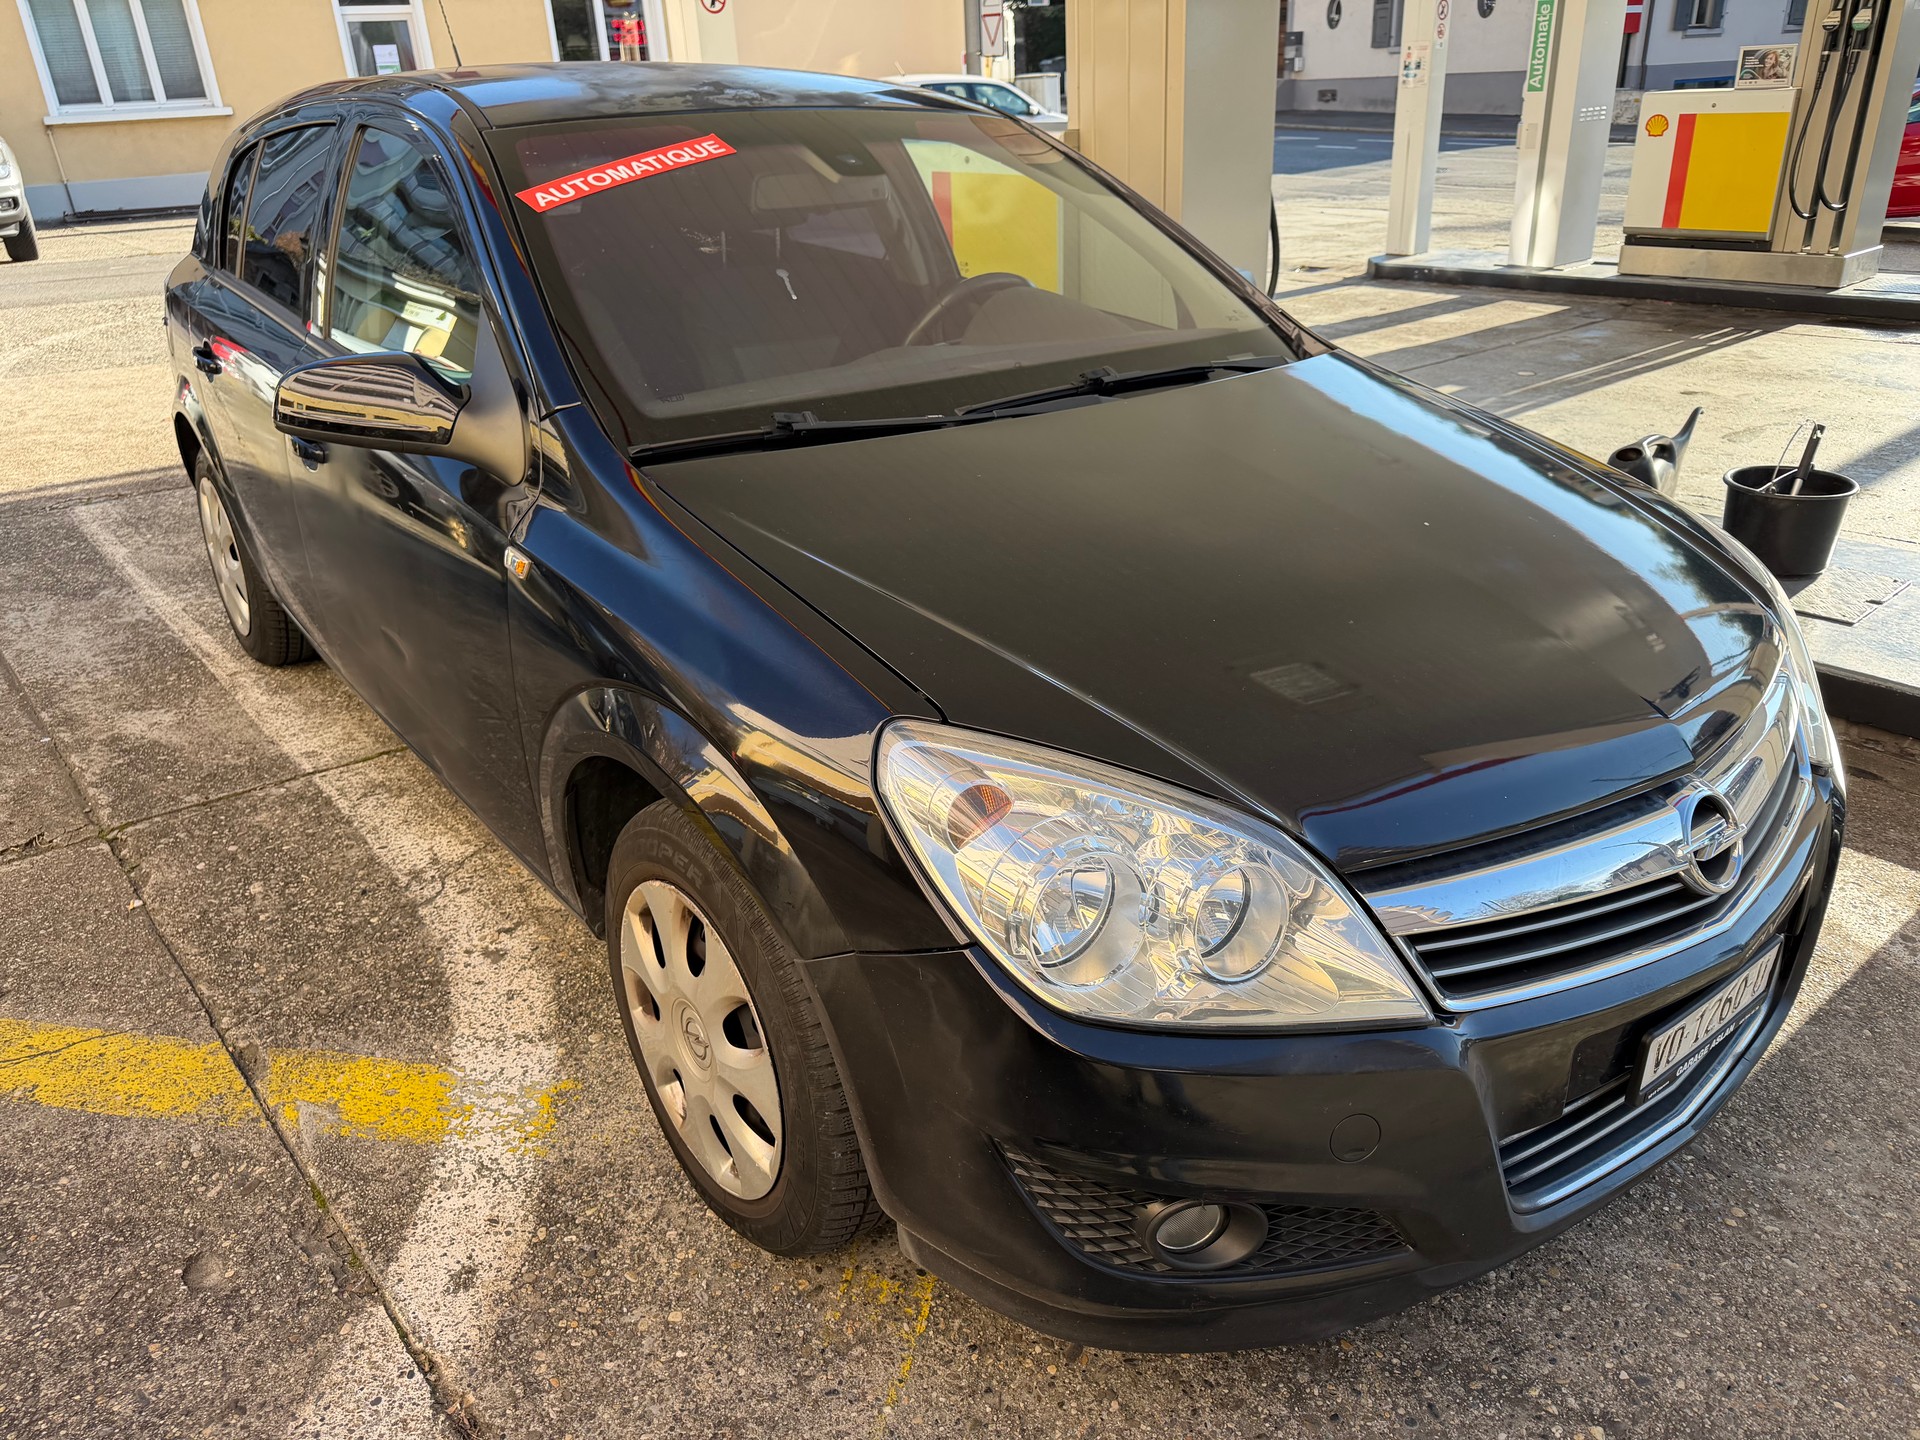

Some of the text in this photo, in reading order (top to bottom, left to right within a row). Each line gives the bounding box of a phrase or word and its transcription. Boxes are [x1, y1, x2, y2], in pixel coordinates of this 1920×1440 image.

[1529, 4, 1551, 88] Automate
[534, 140, 727, 207] AUTOMATIQUE
[621, 838, 704, 891] OOPER
[1676, 1022, 1736, 1077] GARAGE ASLAN
